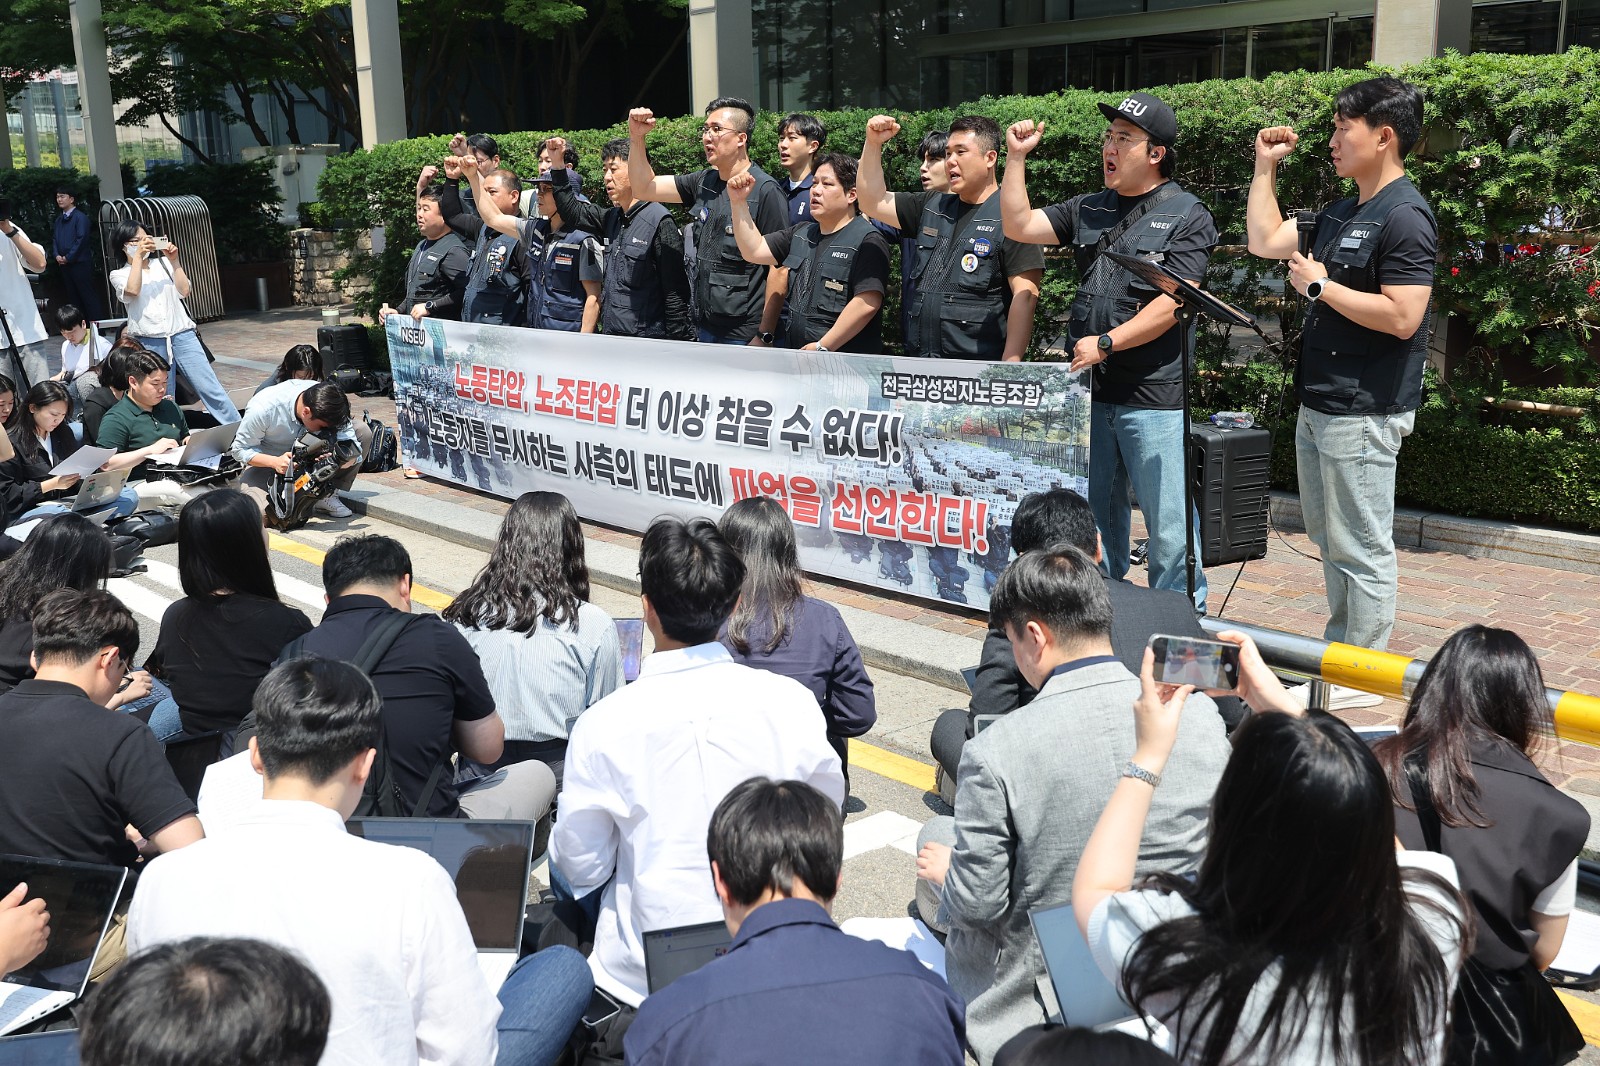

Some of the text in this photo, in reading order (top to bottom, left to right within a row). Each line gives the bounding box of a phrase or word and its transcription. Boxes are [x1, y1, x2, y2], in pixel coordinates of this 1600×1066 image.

[975, 225, 996, 233] NSEU
[1149, 221, 1173, 230] NSEU
[1350, 229, 1370, 239] NSEU
[831, 251, 849, 259] NSEU
[401, 326, 426, 347] NSEU
[882, 373, 1045, 409] 전국삼성전자노동조합
[454, 361, 904, 467] 노동탄압, 노조탄압 더 이상 참을 수 없다!
[428, 409, 989, 556] 노동자를 무시하는 사측의 태도에 파업을 선언한다!
